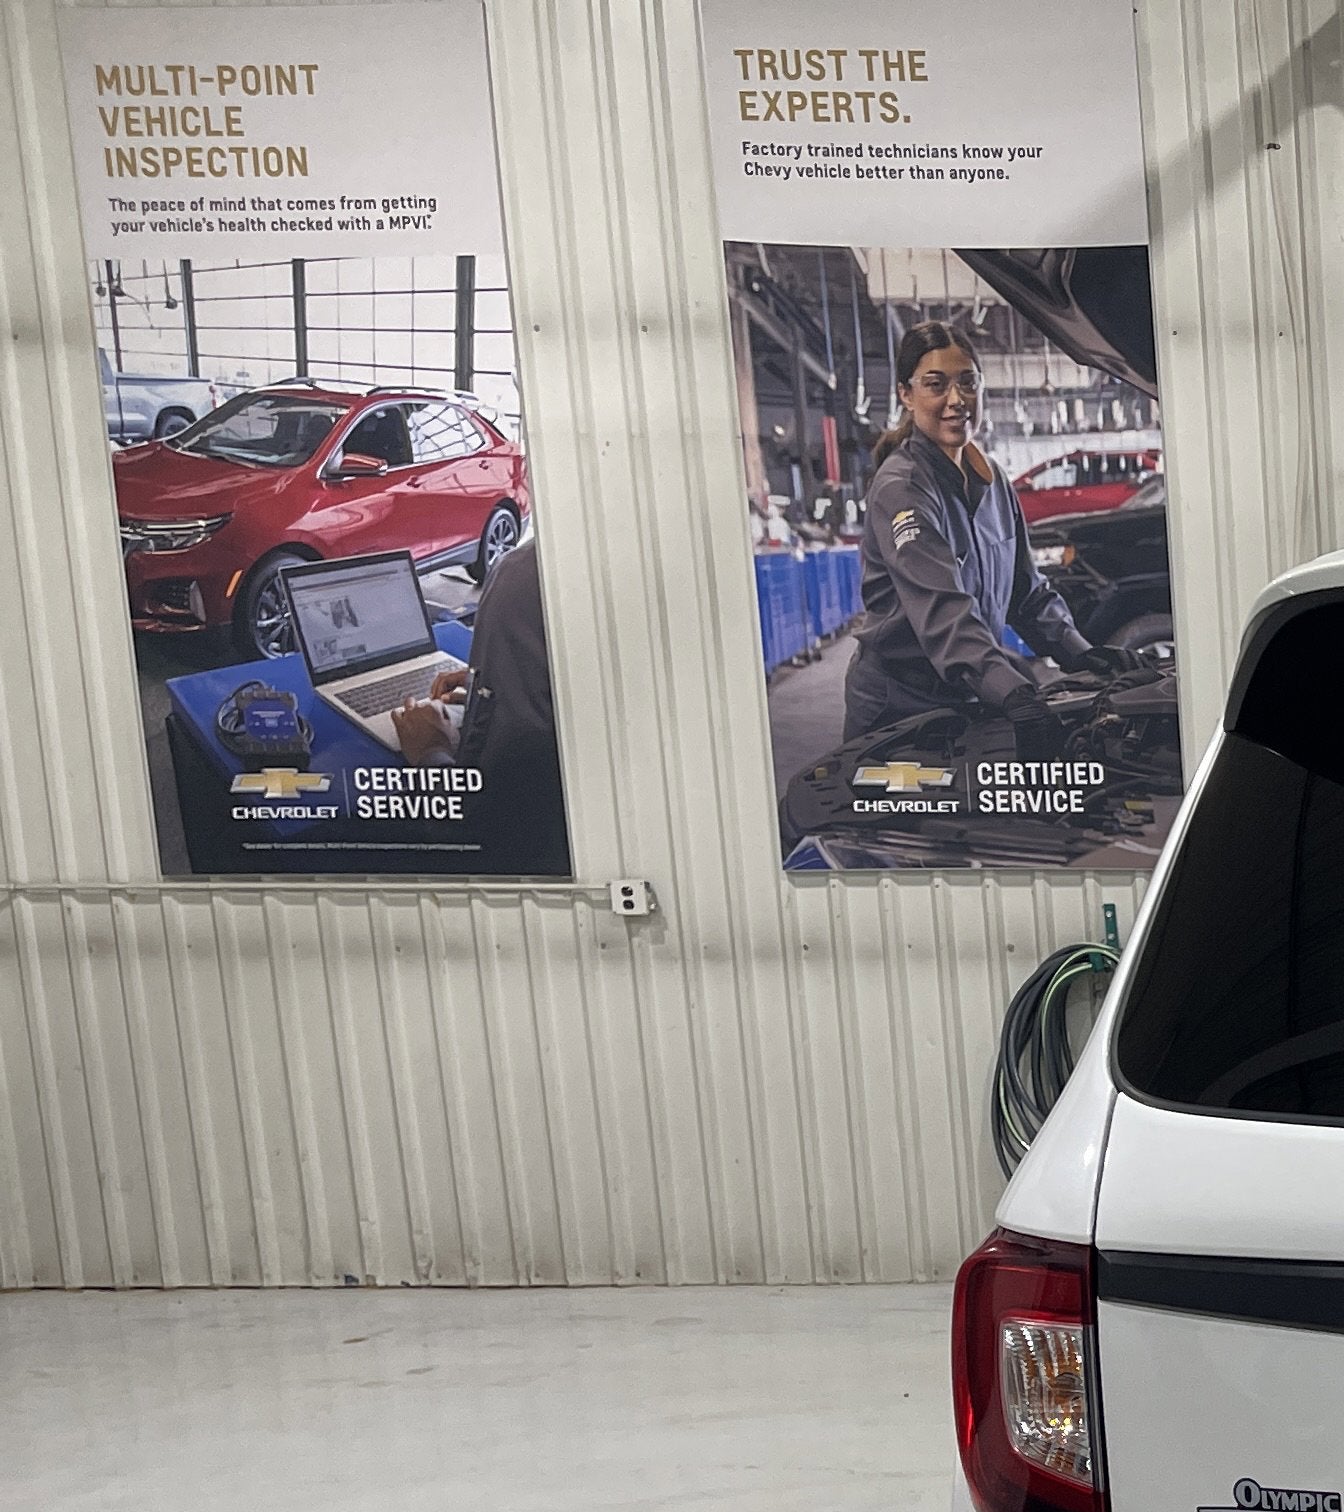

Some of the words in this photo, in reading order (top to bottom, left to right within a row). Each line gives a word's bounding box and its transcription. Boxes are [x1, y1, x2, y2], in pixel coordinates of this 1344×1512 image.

[734, 49, 849, 81] TRUST
[859, 50, 928, 82] THE
[95, 64, 318, 97] MULTI-POINT
[739, 90, 912, 124] EXPERTS.
[98, 106, 244, 138] VEHICLE
[104, 146, 309, 178] INSPECTION
[742, 142, 802, 160] Factory
[807, 142, 864, 158] trained
[867, 143, 958, 159] technicians
[962, 143, 1003, 160] know
[1008, 146, 1043, 162] your
[744, 162, 792, 181] Chevy
[796, 163, 851, 179] vehicle
[855, 163, 904, 180] better
[909, 164, 944, 180] than
[949, 167, 1010, 184] anyone.
[108, 197, 136, 212] The
[141, 199, 185, 215] peace
[190, 197, 204, 211] of
[210, 197, 246, 211] mind
[250, 197, 283, 211] that
[287, 199, 336, 211] comes
[339, 196, 377, 210] from
[381, 196, 437, 214] getting
[111, 219, 145, 236] your
[149, 217, 214, 232] vehicle's
[219, 217, 266, 232] health
[271, 216, 333, 231] checked
[337, 215, 371, 230] with
[375, 219, 384, 230] a
[354, 767, 483, 791] CERTIFIED
[977, 762, 1104, 786] CERTIFIED
[232, 806, 339, 820] CHEVROLET
[357, 796, 464, 820] SERVICE
[853, 799, 960, 814] CHEVROLET
[979, 791, 1085, 814] SERVICE
